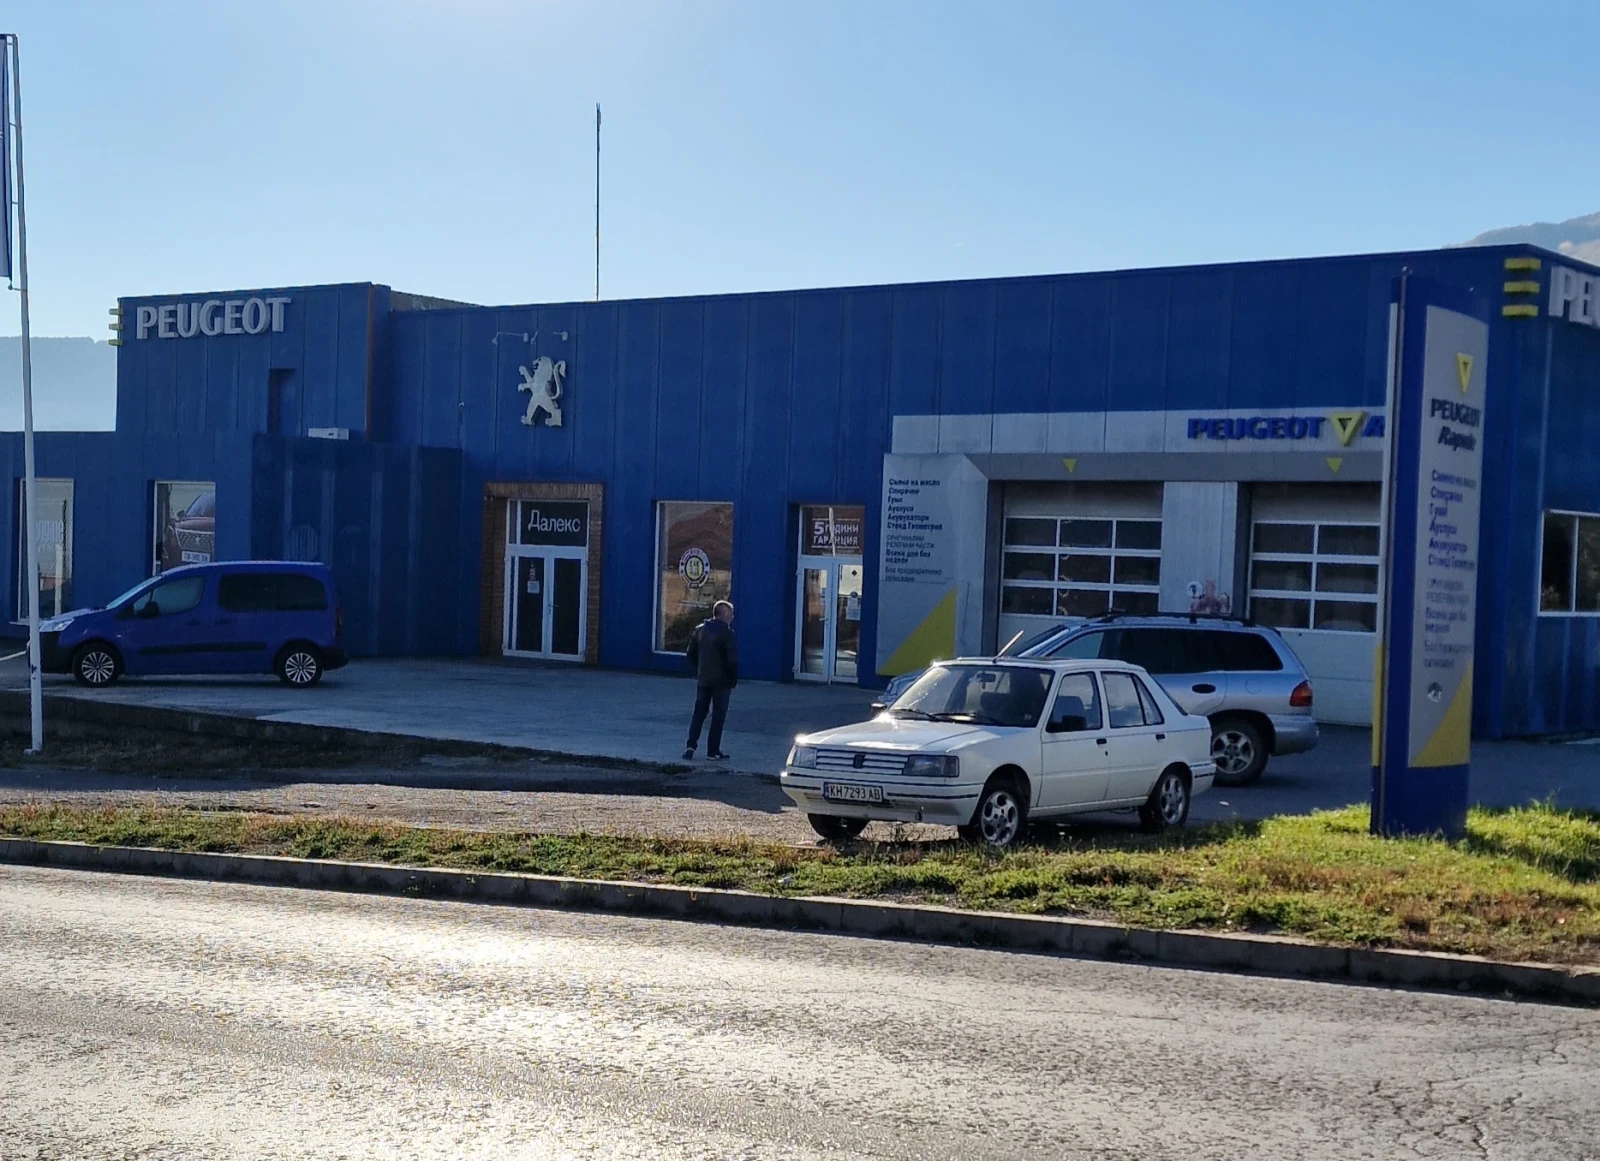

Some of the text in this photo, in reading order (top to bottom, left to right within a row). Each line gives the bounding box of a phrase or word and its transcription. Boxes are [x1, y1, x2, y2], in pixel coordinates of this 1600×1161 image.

[1548, 265, 1600, 330] PE
[136, 297, 291, 340] PEUGEOT
[1187, 416, 1326, 440] PEUGEOT
[528, 509, 581, 532] Далекс
[813, 521, 825, 535] 5
[812, 535, 859, 546] ГАРАНЦИЯ
